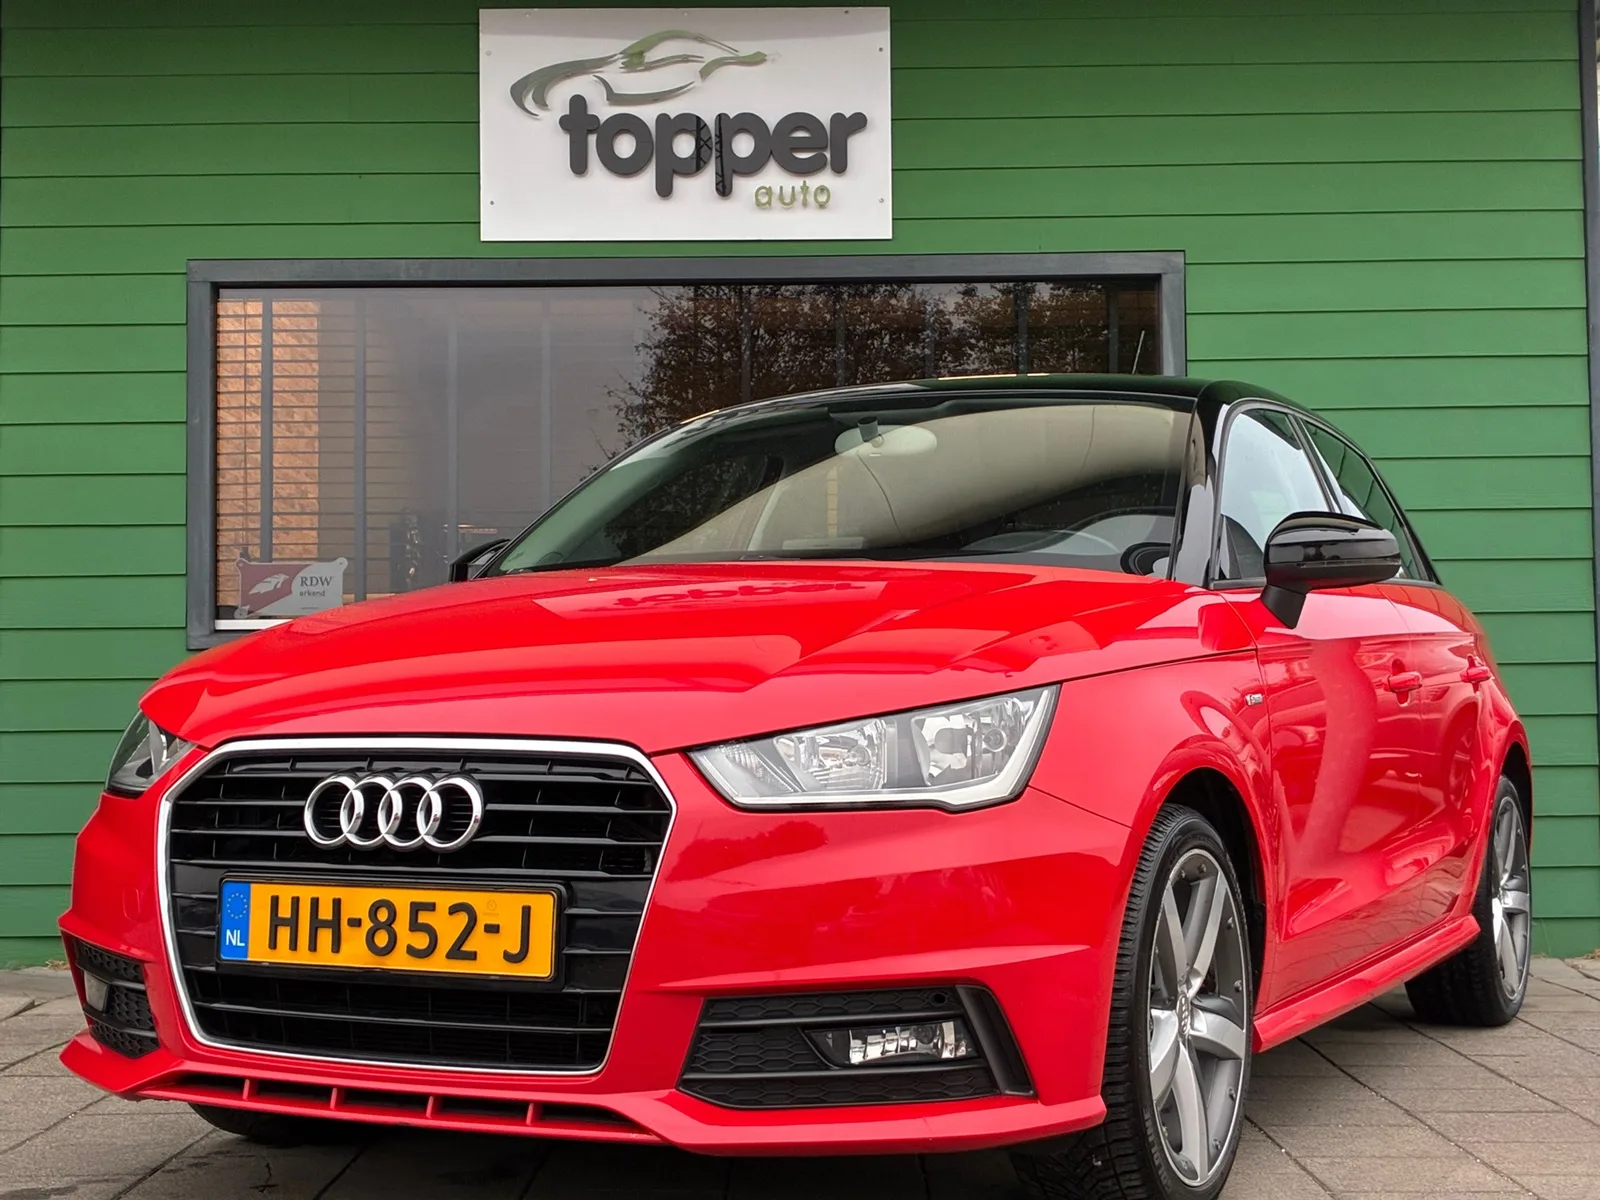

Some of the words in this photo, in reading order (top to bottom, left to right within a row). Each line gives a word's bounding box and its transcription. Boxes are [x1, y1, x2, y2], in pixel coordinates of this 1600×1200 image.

[559, 94, 868, 198] topper
[754, 180, 832, 208] auto
[300, 575, 333, 587] RDW
[299, 589, 326, 597] erkend
[225, 929, 246, 948] NL
[268, 894, 532, 965] HH-852-J
